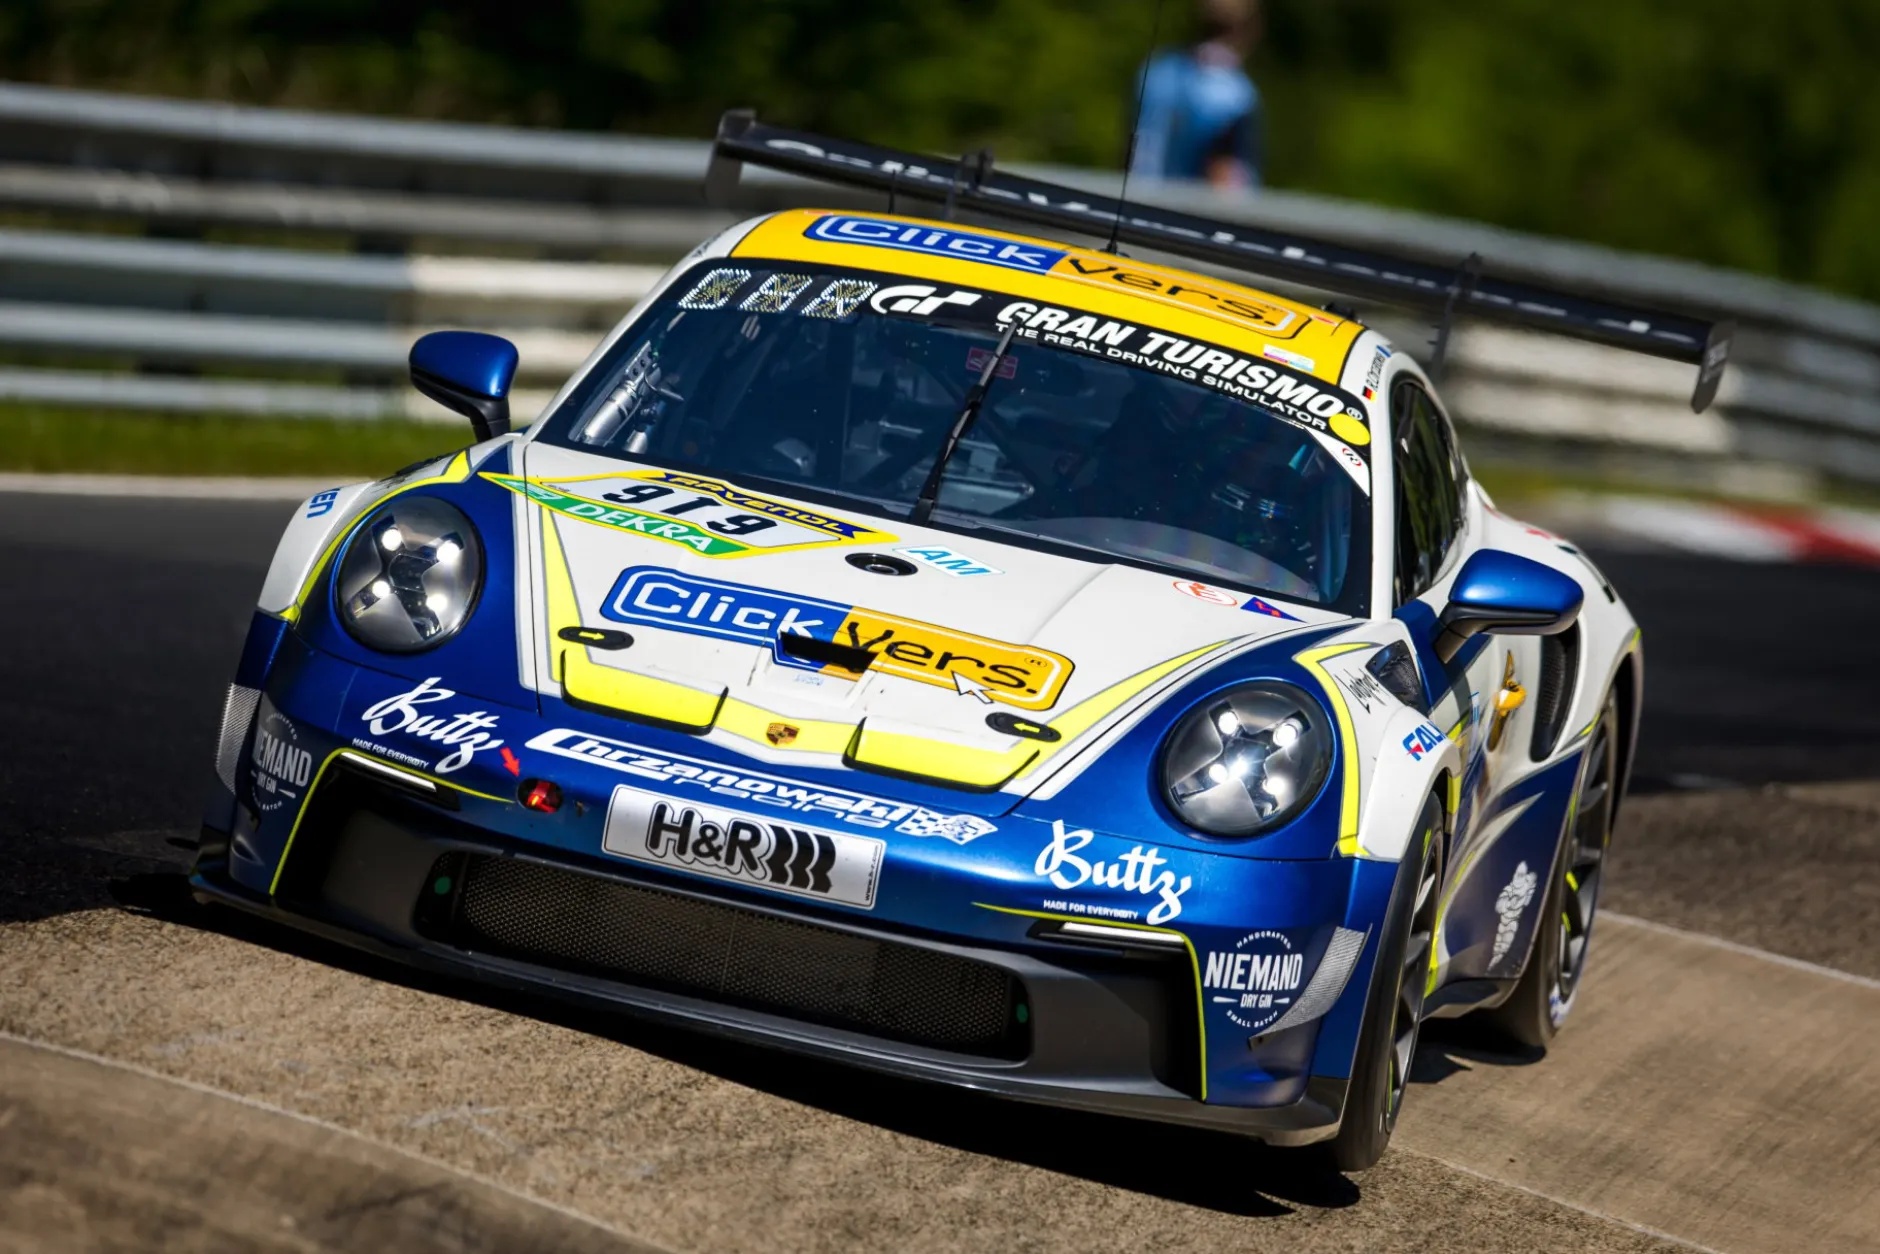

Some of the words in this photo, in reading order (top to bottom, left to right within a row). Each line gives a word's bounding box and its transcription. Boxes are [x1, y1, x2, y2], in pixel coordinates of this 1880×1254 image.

[837, 220, 1047, 266] Click
[995, 323, 1038, 339] THE
[1044, 333, 1102, 354] REAL
[1106, 346, 1197, 379] DRIVING
[1202, 373, 1328, 431] SIMULATOR
[997, 302, 1136, 346] GRAN
[1138, 331, 1345, 418] TURISMO
[564, 503, 713, 552] DEKRA
[906, 549, 992, 575] AM
[633, 582, 825, 641] Click
[352, 737, 371, 751] MADE
[372, 743, 387, 755] FOR
[525, 728, 918, 823] Chrzanowski
[645, 800, 770, 881] H&R
[1043, 899, 1068, 911] MADE
[1069, 902, 1086, 914] FOR
[1235, 930, 1292, 950] HANDCRAFTED
[1203, 951, 1304, 991] NIEMAND
[1226, 1009, 1251, 1028] SMALL
[1253, 1009, 1278, 1028] BATCH
[1240, 993, 1258, 1008] DRY
[1258, 993, 1274, 1009] GIN
